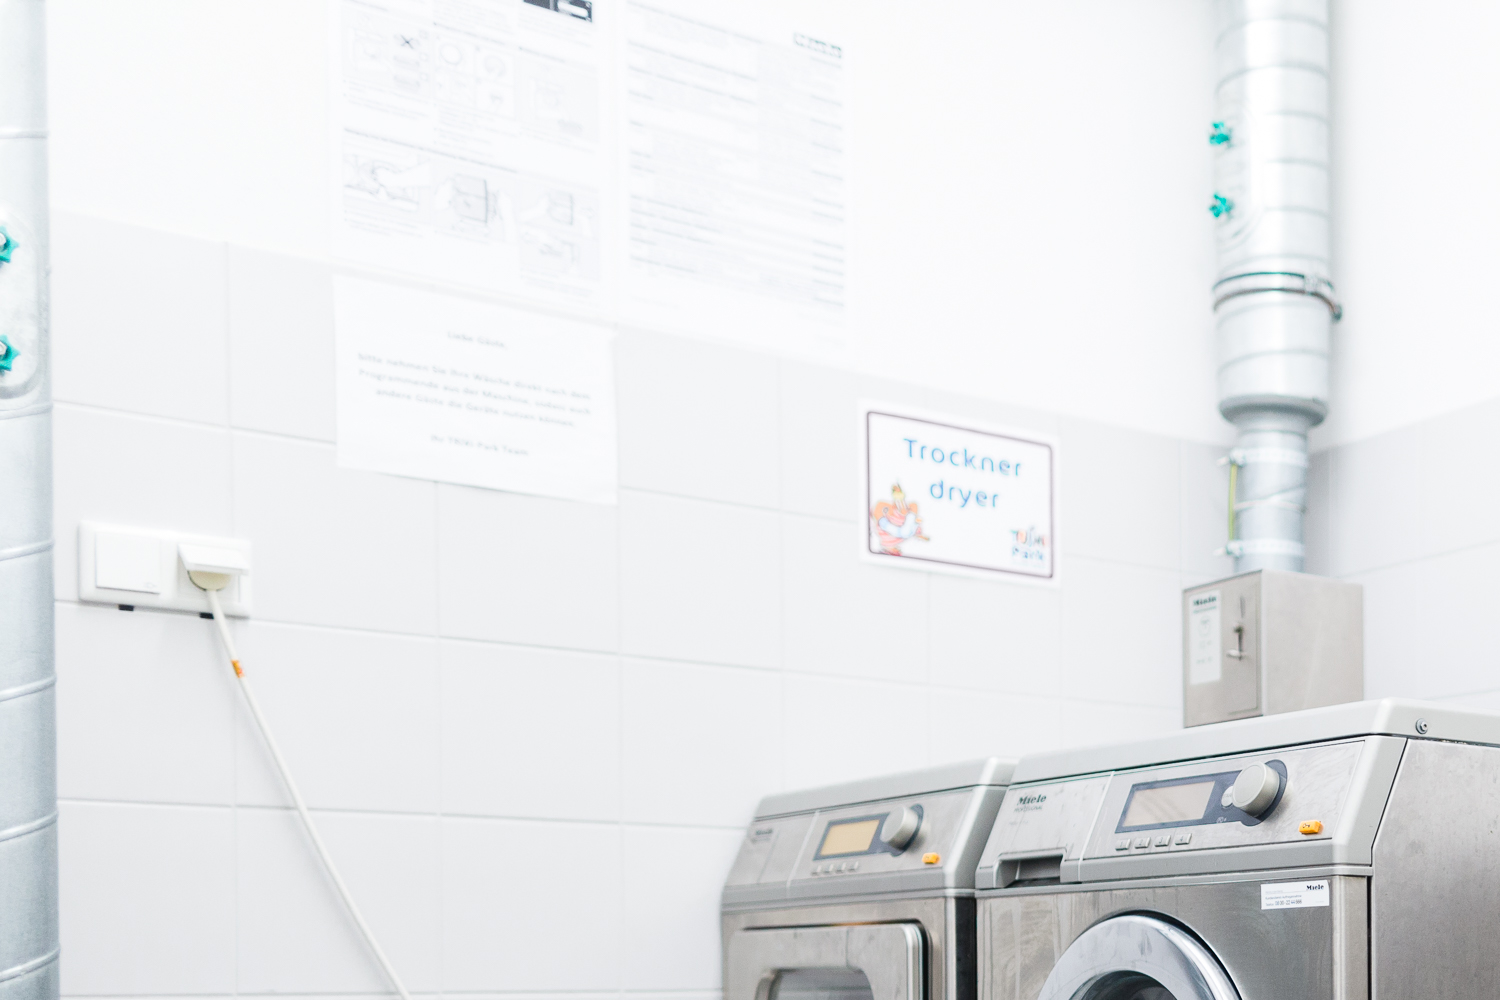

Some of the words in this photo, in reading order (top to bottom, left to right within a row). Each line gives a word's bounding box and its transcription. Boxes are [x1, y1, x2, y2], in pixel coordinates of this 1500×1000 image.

[903, 437, 1021, 477] Trockner
[929, 479, 999, 509] dryer
[1017, 794, 1047, 805] Miele
